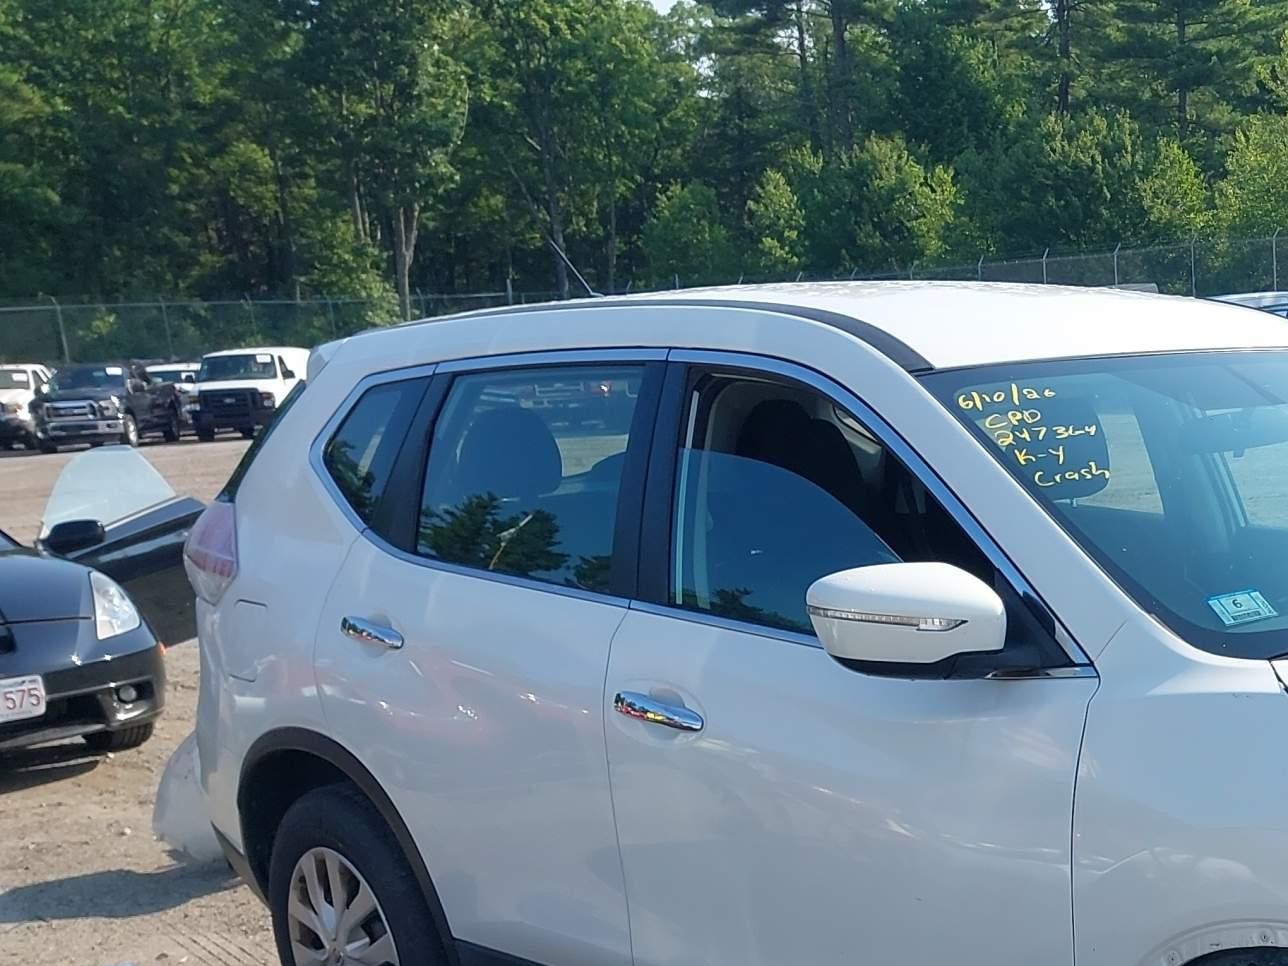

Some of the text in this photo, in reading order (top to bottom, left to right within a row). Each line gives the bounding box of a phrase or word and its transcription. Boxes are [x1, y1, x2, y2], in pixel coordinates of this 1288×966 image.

[958, 383, 1056, 411] 6/10/26
[985, 409, 1041, 428] CPD
[1034, 461, 1110, 486] Crash
[1231, 598, 1243, 609] 6
[3, 687, 41, 711] 575
